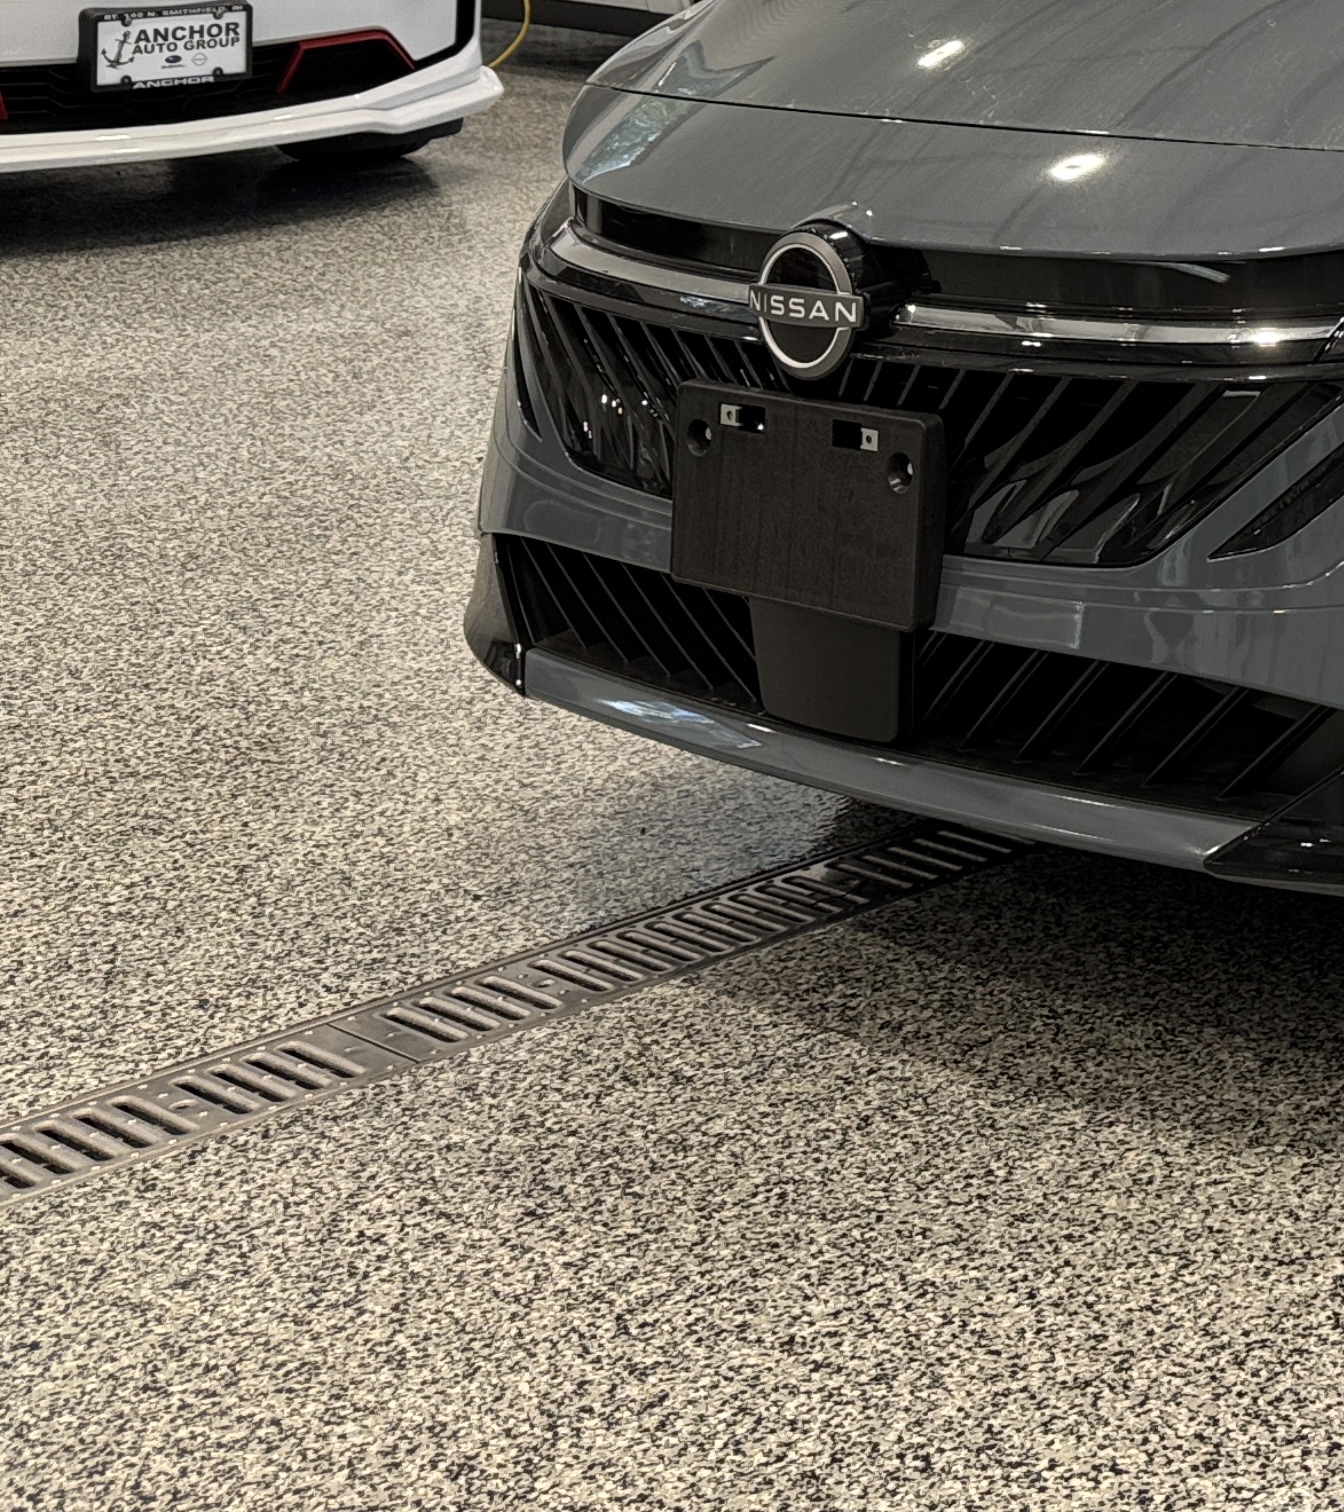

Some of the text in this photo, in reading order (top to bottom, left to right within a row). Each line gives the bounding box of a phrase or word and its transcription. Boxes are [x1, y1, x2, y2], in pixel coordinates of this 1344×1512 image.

[134, 22, 240, 44] ANCHOR
[131, 36, 241, 55] AUTO GROUP
[133, 75, 215, 90] ANCHOR
[750, 289, 857, 323] NISSAN
